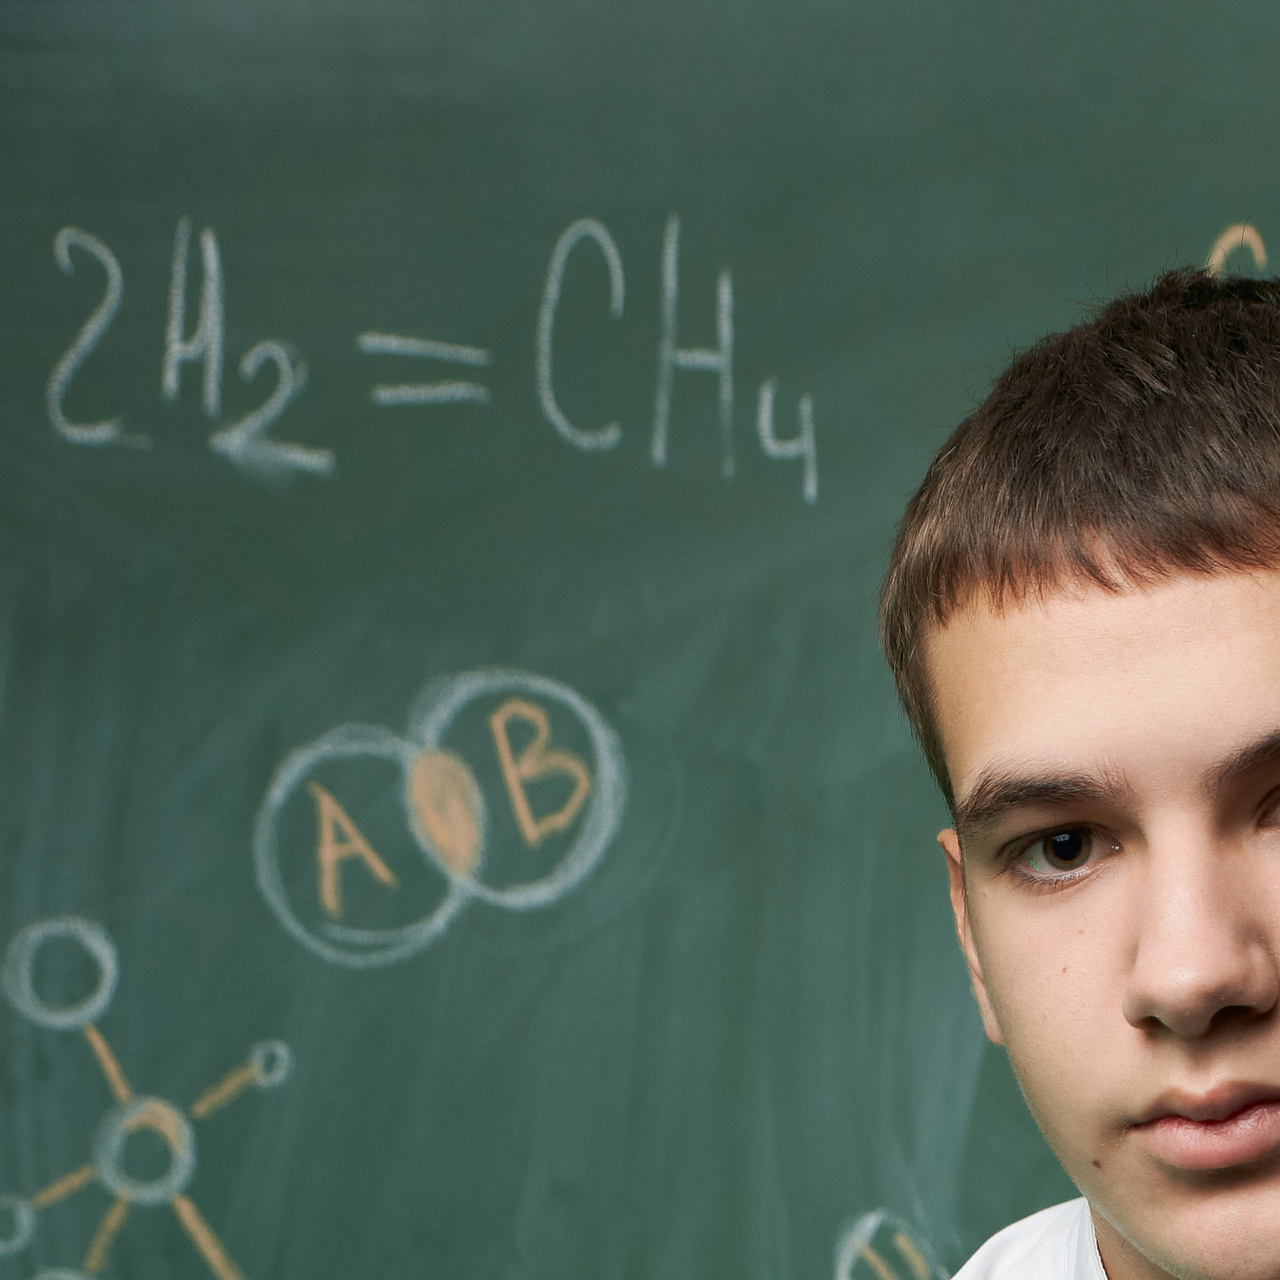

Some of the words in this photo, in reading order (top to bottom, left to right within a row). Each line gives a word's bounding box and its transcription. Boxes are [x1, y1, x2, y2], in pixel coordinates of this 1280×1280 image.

[535, 211, 819, 505] CH4
[489, 697, 592, 849] B
[309, 780, 398, 919] A
